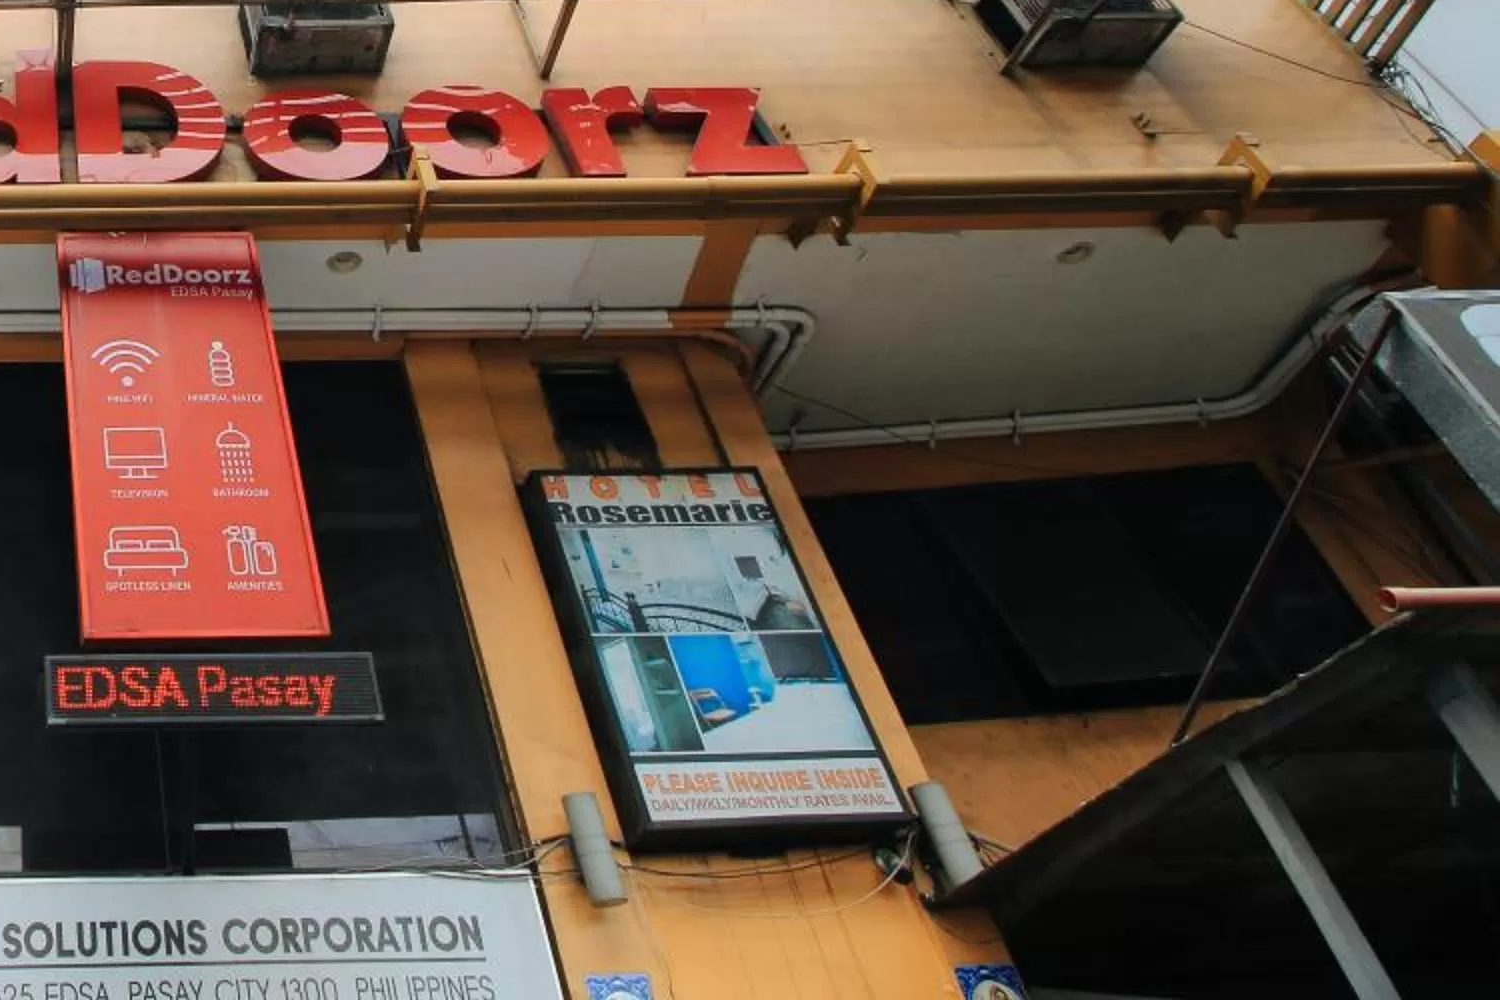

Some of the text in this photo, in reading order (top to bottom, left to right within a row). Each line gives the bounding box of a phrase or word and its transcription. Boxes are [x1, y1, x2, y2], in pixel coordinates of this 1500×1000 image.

[106, 263, 252, 285] RedDoorz
[171, 286, 209, 297] EDSA
[541, 474, 764, 500] HOTEL
[550, 499, 773, 524] Rosemarie
[56, 664, 336, 717] EDSA Pasay
[643, 767, 886, 793] PLEASE INQUIRE INSIDE
[2, 918, 208, 959] SOLUTIONS
[222, 915, 485, 955] CORPORATION
